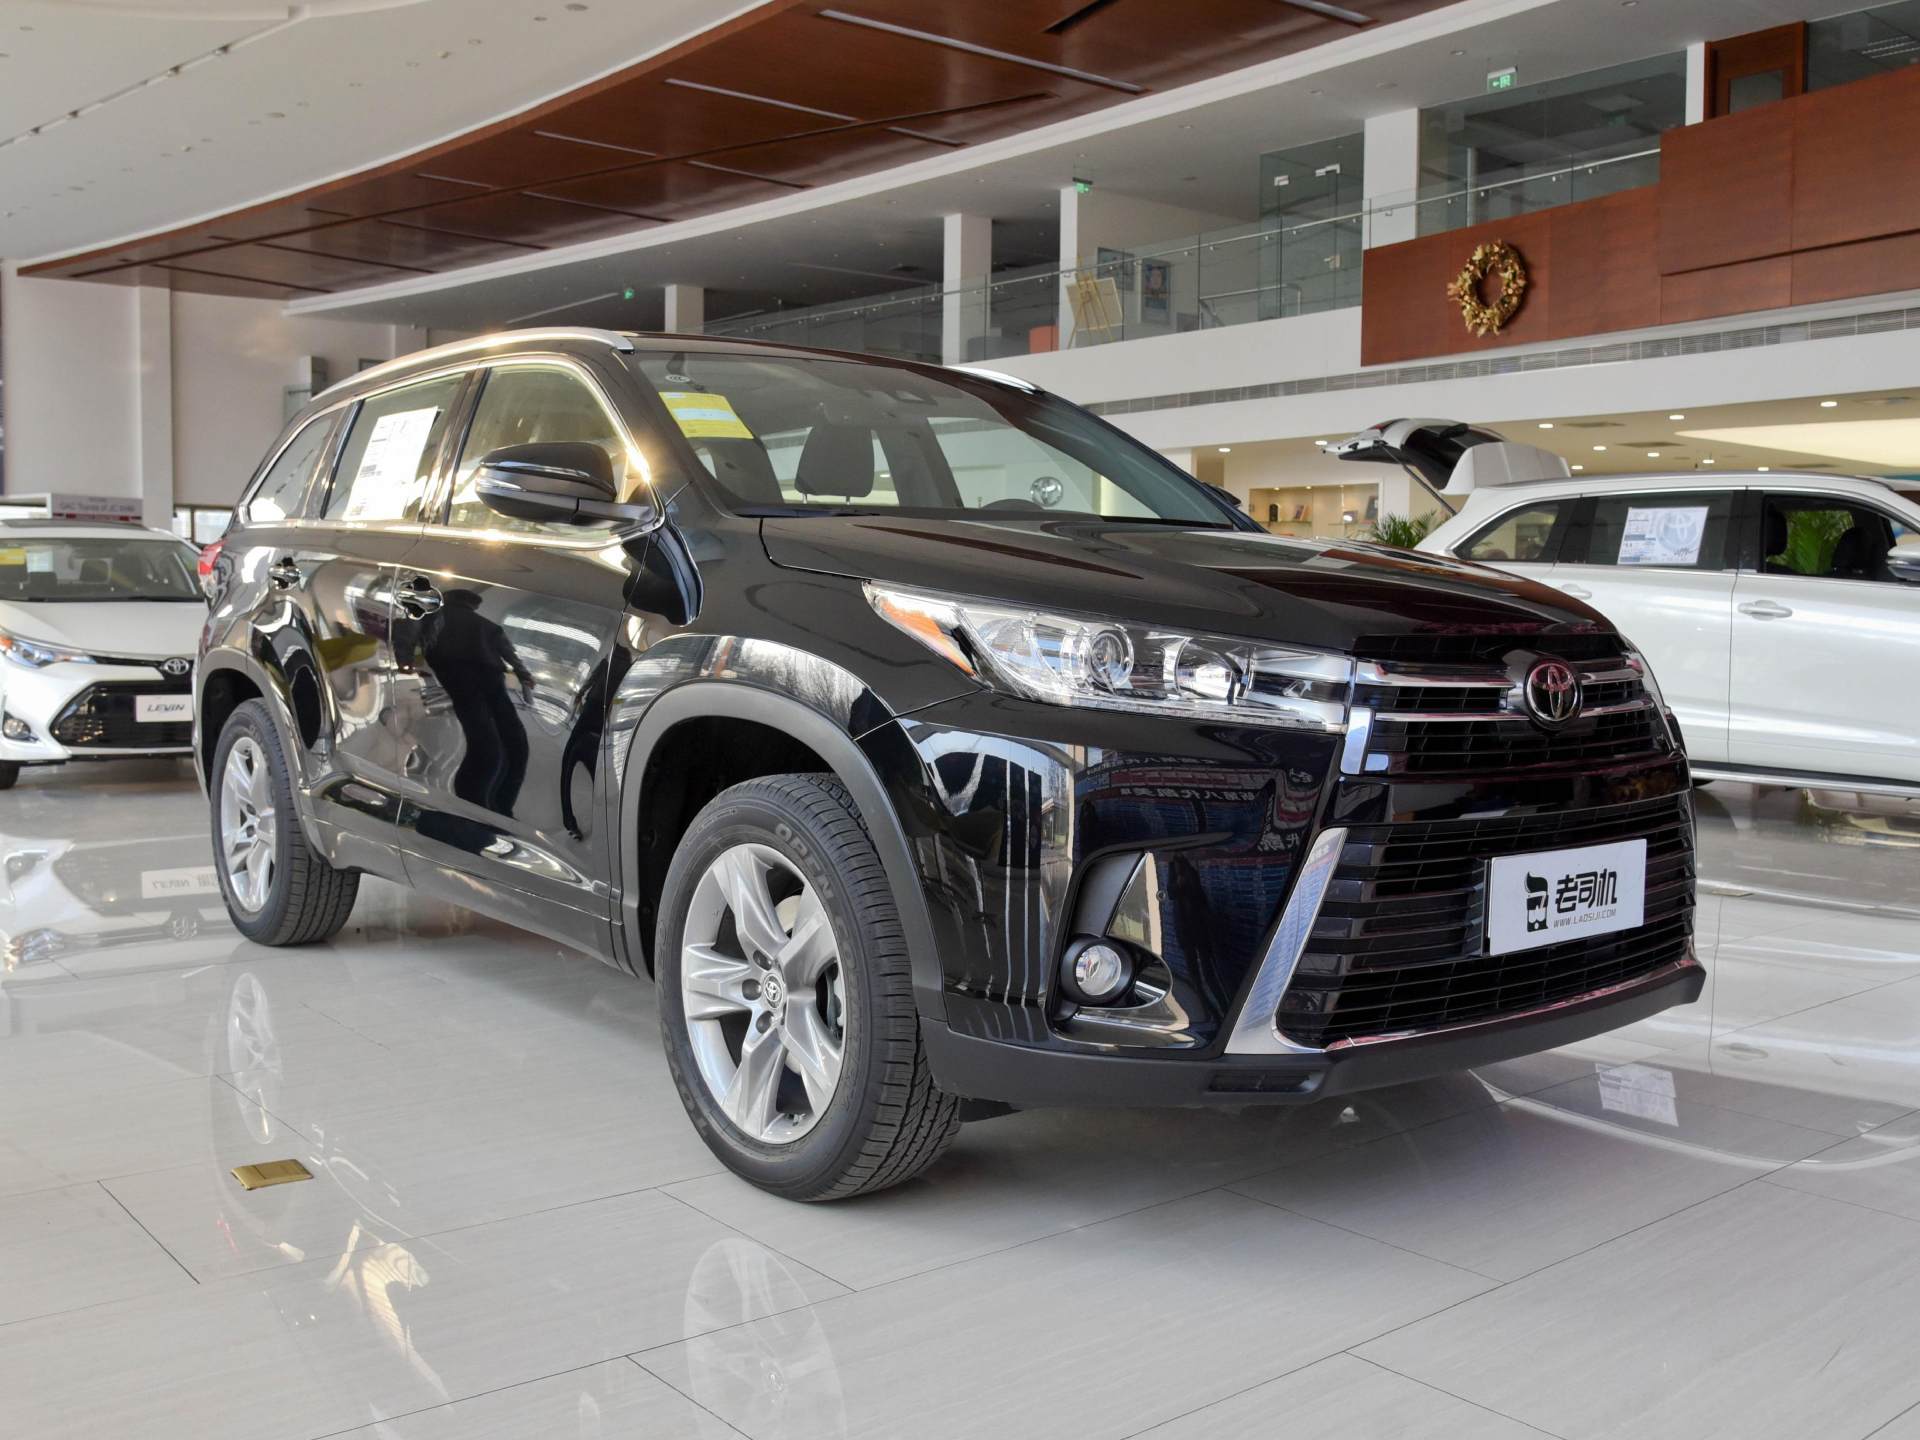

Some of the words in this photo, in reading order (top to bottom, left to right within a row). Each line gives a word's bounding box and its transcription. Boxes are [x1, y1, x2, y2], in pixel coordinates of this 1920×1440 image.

[1554, 868, 1618, 914] 老司机
[1553, 908, 1617, 929] WWW.LAOSIJI.COM
